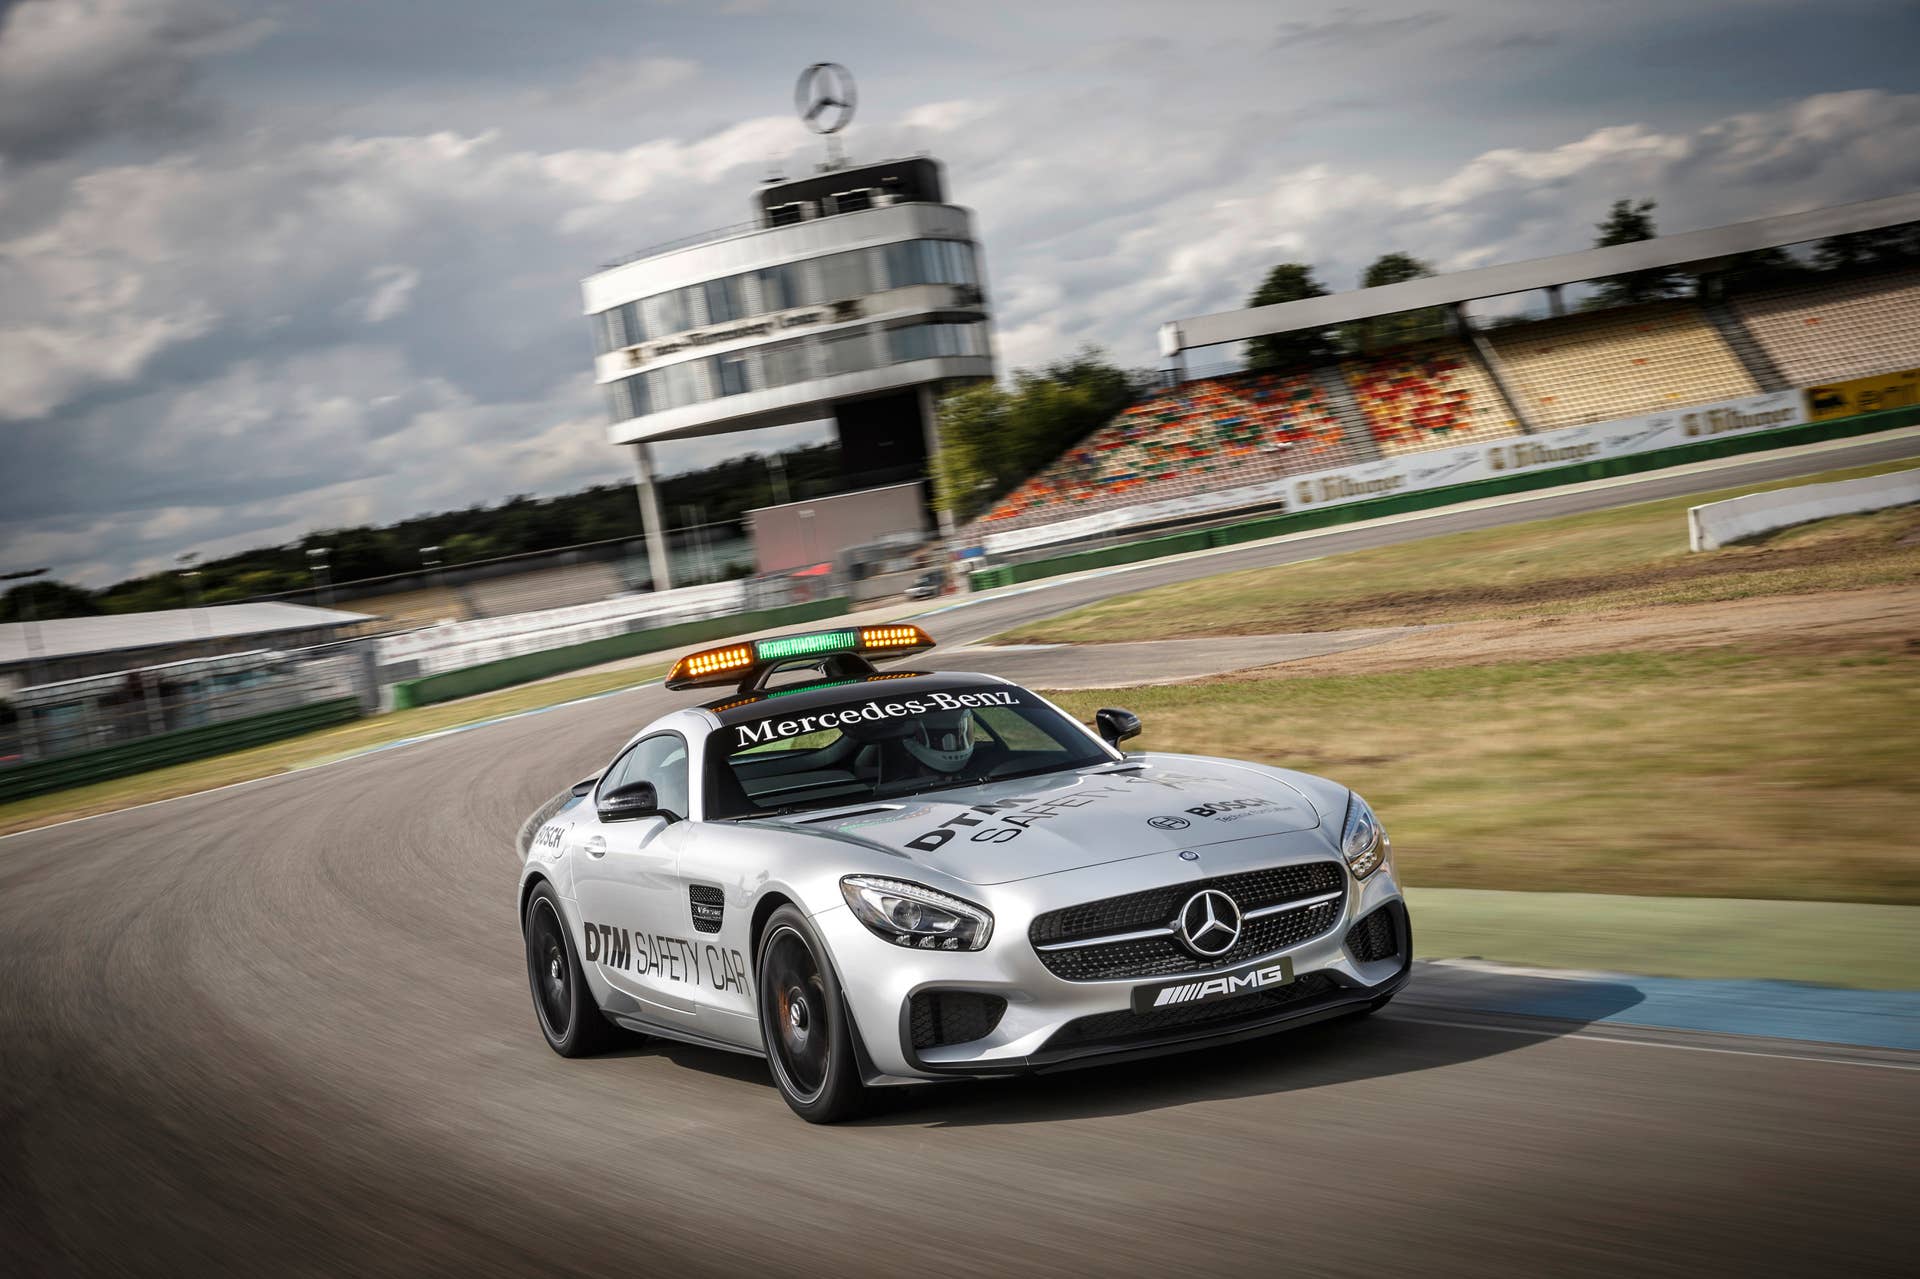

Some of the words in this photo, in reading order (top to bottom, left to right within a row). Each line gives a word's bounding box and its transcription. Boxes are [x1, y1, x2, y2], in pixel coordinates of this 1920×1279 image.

[736, 684, 1020, 748] Mercedes-Benz
[904, 798, 1038, 852] DTM
[970, 786, 1131, 844] SAFETY
[1184, 797, 1279, 818] BOSCH
[584, 921, 631, 971] DTM
[635, 931, 701, 985] SAFETY
[706, 944, 751, 997] CAR
[1196, 965, 1282, 1000] AMG
